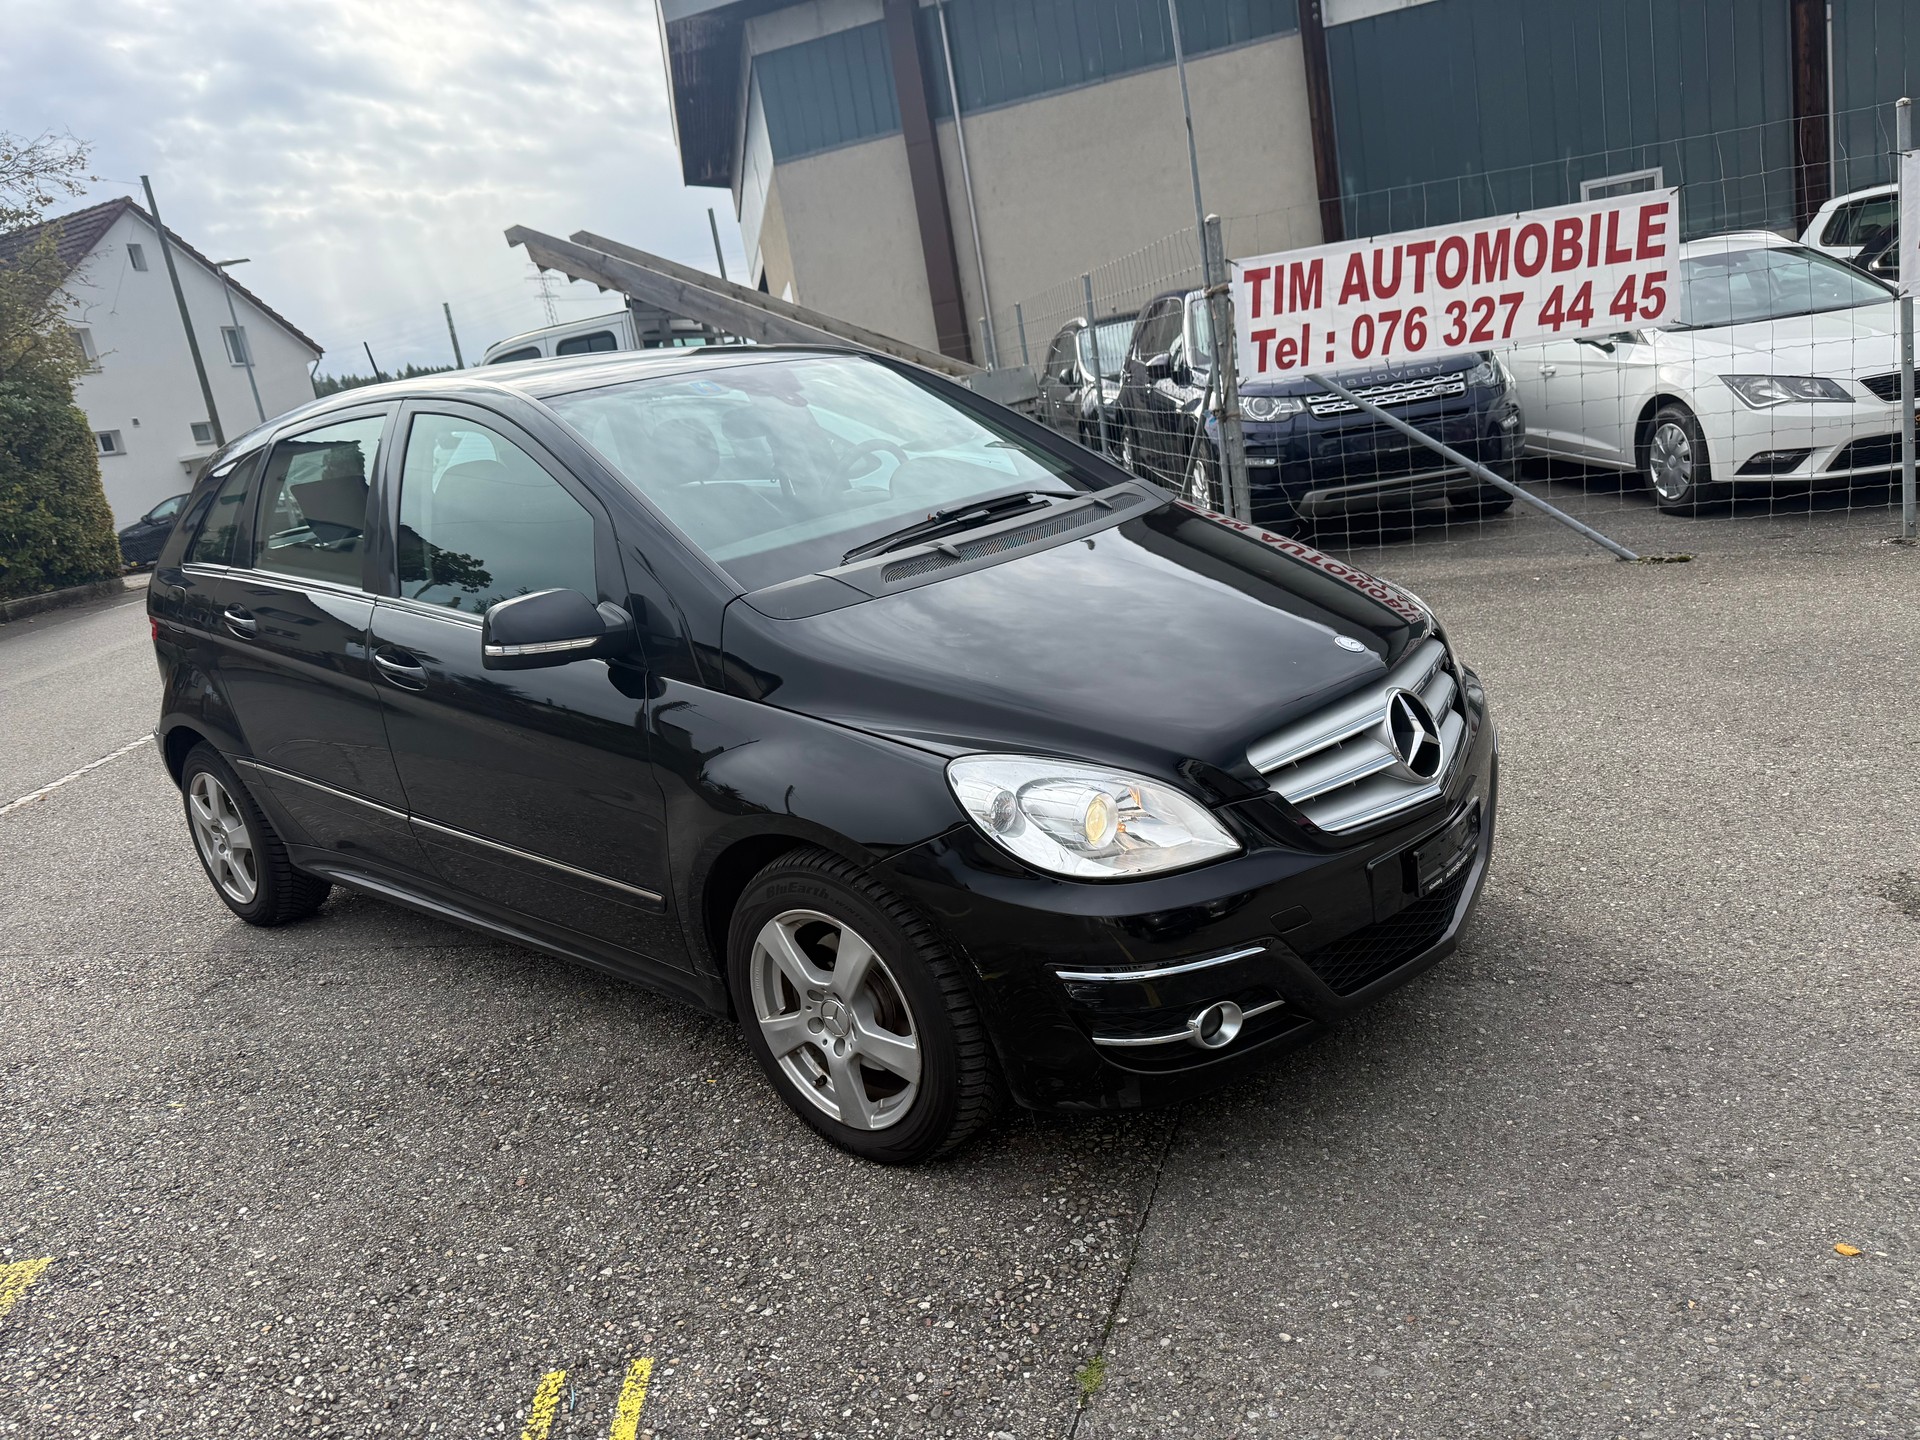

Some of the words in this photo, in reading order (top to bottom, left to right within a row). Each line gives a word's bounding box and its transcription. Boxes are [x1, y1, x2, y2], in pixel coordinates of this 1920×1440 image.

[1243, 258, 1324, 319] TIM
[1338, 202, 1669, 305] AUTOMOBILE
[1251, 323, 1311, 373] Tel
[1351, 306, 1428, 360] 076
[1443, 291, 1524, 347] 327
[1538, 280, 1595, 332] 44
[1609, 271, 1668, 322] 45
[1337, 364, 1443, 388] ISCOVERY
